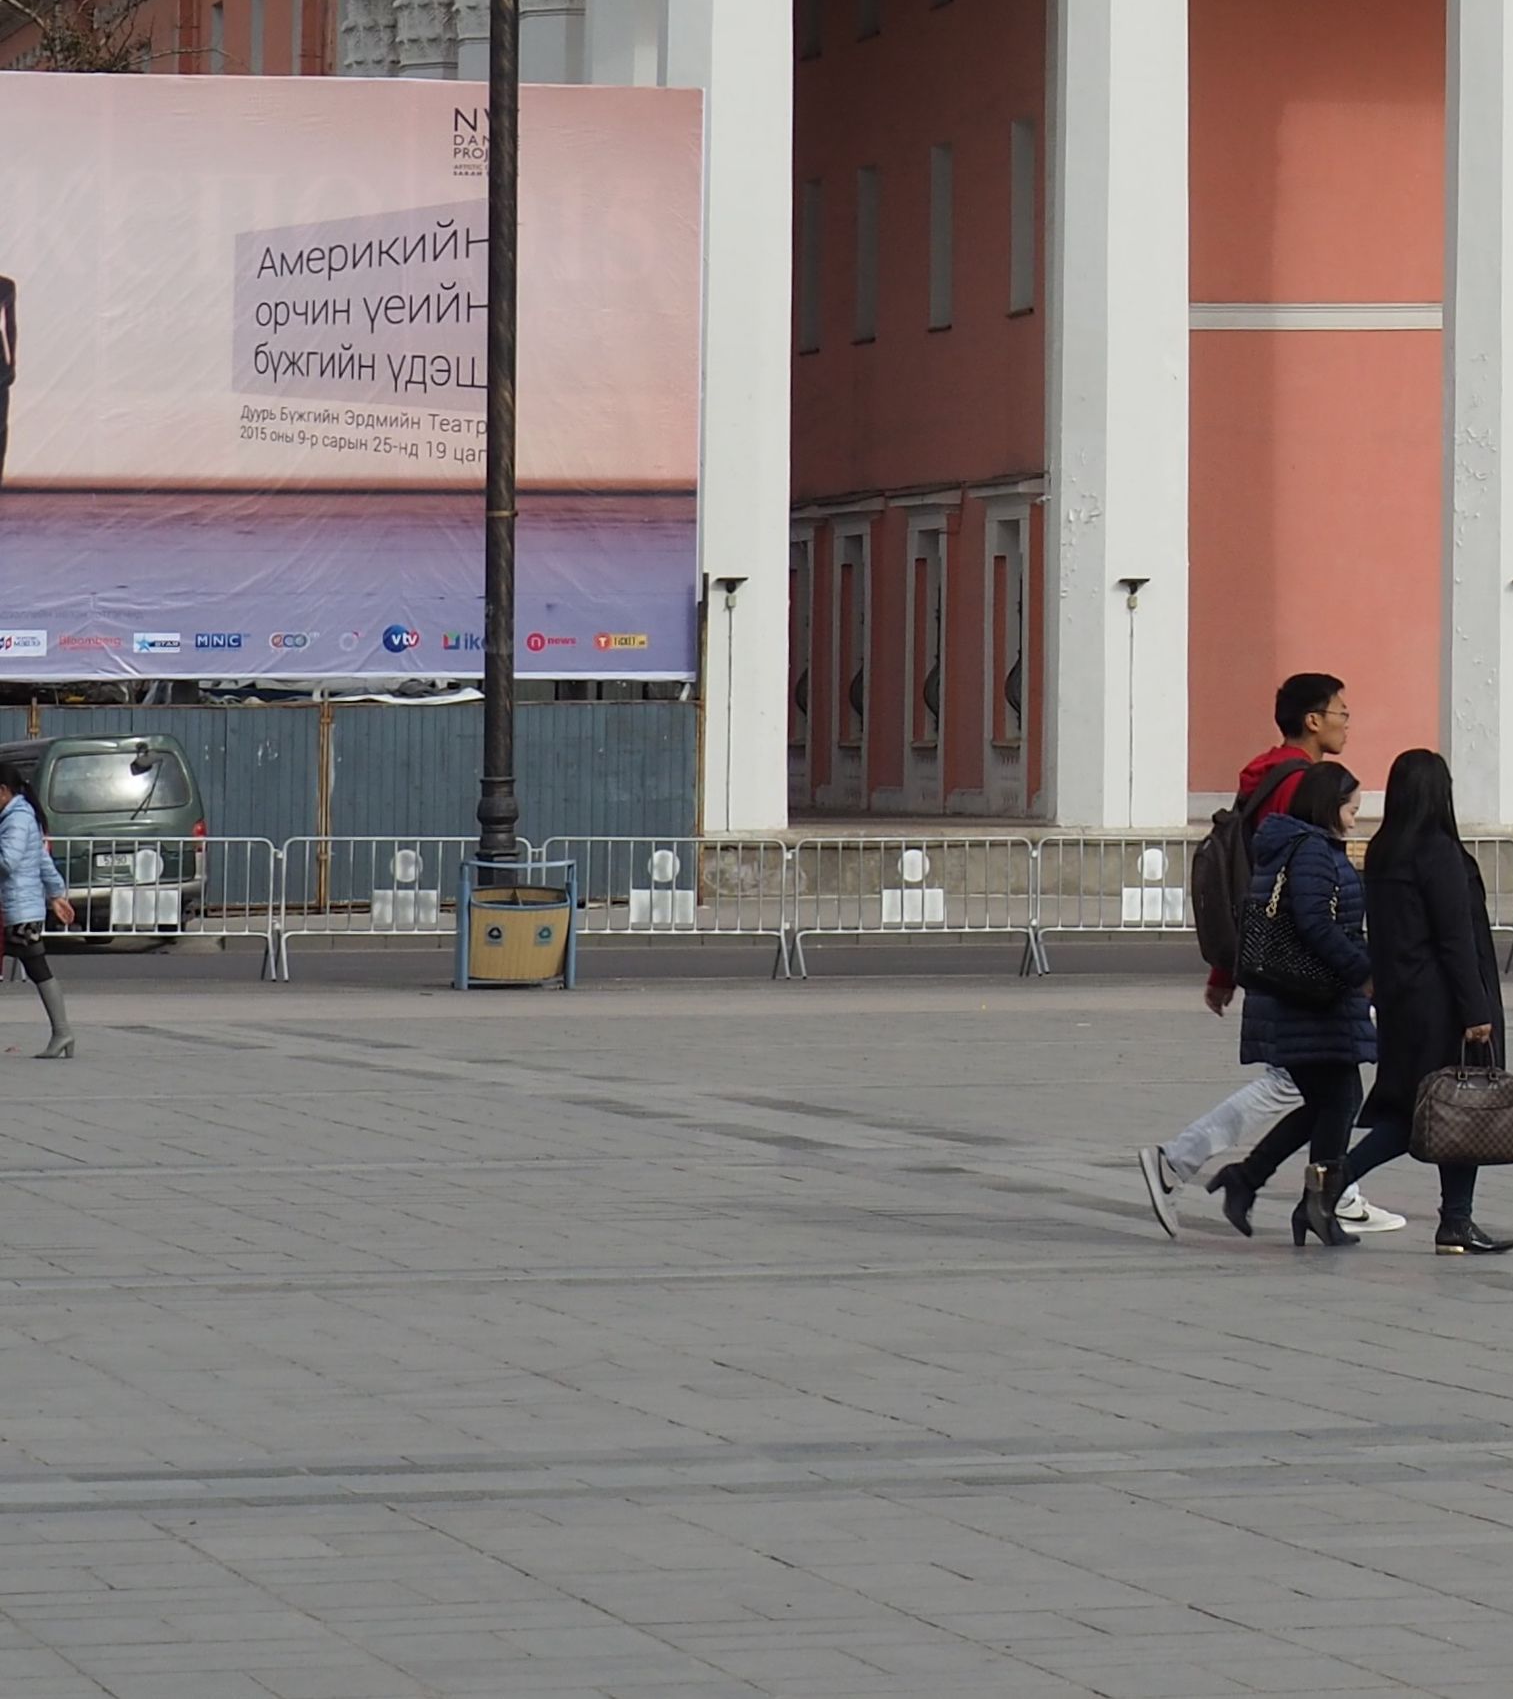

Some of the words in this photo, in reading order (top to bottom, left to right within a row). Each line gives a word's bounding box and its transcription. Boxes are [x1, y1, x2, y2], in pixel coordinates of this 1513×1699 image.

[256, 219, 489, 281] Америкийн
[255, 297, 350, 334] орчин
[363, 281, 489, 334] үеийн
[254, 342, 375, 383] бүжгийн
[240, 404, 276, 423] Дуурь
[280, 406, 339, 426] Бүжгийн
[344, 409, 420, 431] Эрдмийн
[240, 425, 267, 441] 2015
[270, 432, 294, 443] оны
[297, 430, 318, 448] 9-р
[322, 434, 368, 453] сарын
[373, 436, 418, 460] 25-нд
[426, 440, 446, 460] 19
[196, 634, 242, 648] MNC
[391, 632, 418, 647] vtv
